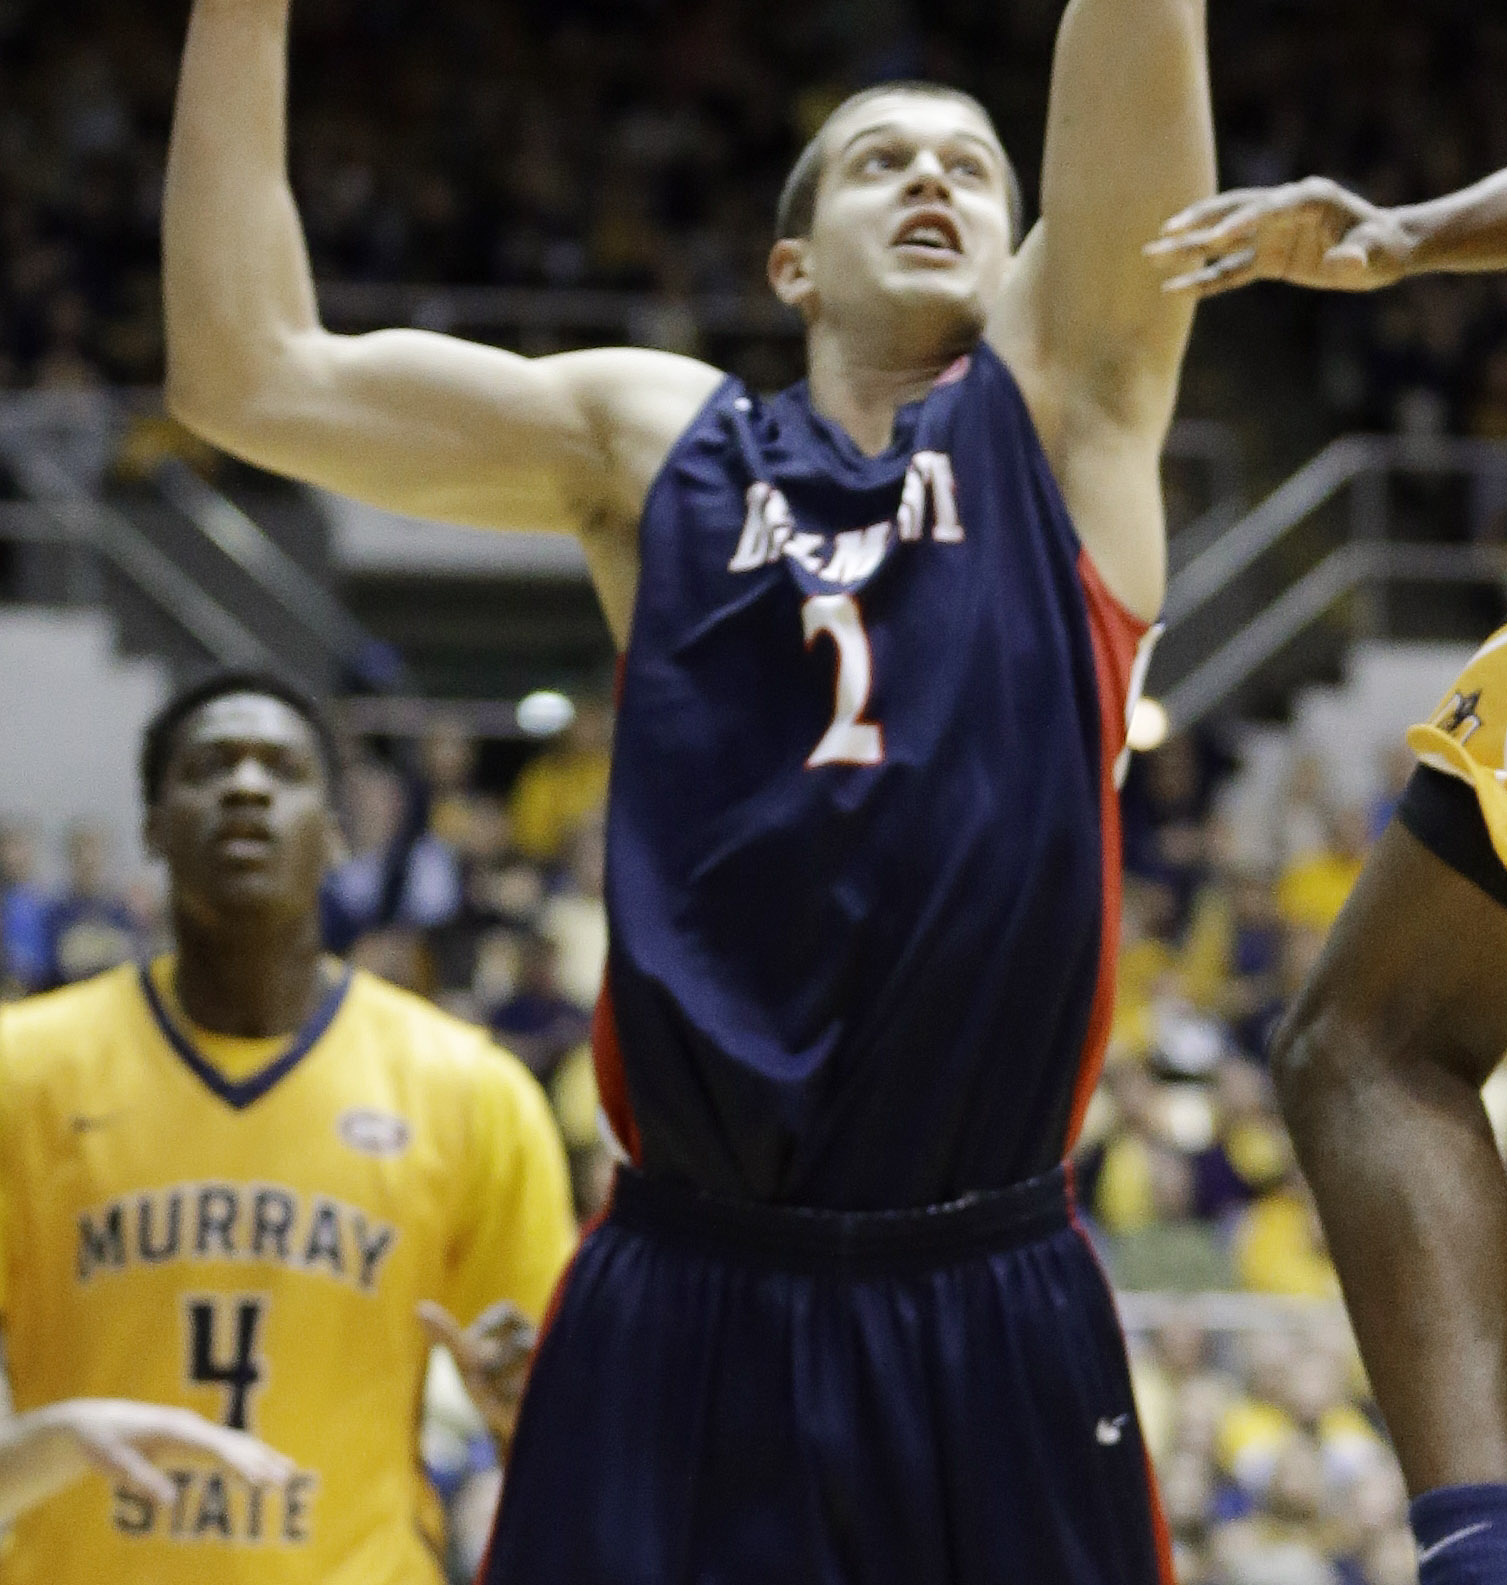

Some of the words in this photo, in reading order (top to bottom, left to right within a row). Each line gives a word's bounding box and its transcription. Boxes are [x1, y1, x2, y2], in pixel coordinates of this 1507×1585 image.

[801, 592, 886, 771] 2
[77, 1182, 398, 1295] MURRAY
[182, 1292, 269, 1432] 4
[112, 1466, 318, 1544] STATE
